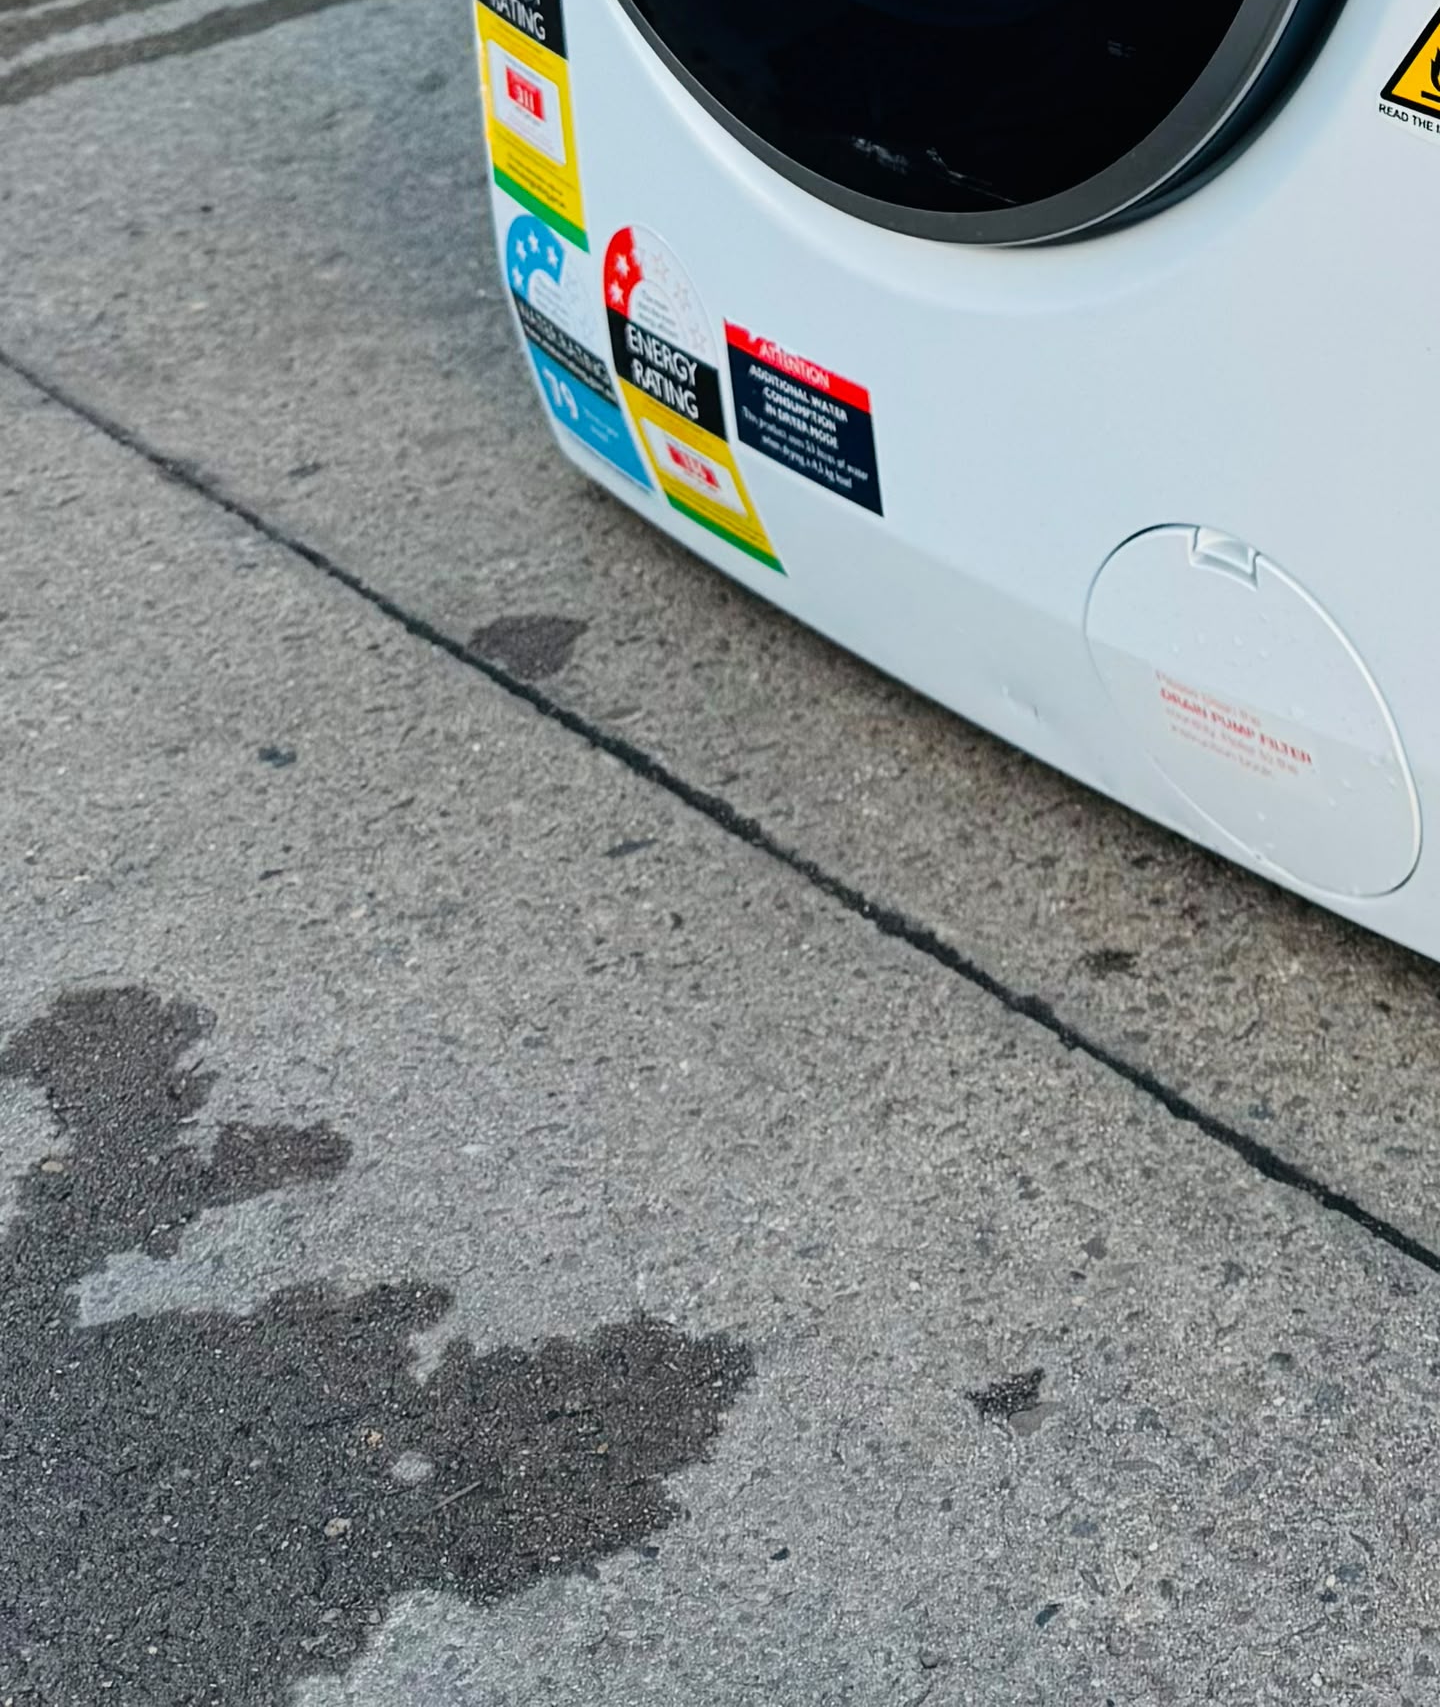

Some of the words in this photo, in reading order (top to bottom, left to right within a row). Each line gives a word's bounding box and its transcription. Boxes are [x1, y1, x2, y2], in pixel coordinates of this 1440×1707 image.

[1378, 102, 1410, 123] READ
[1412, 114, 1434, 132] THE
[625, 322, 698, 387] ENERGY
[758, 341, 831, 390] ATTENTION
[631, 355, 700, 421] RATING
[748, 364, 811, 404] ADDITIONAL
[810, 394, 849, 424] WATER
